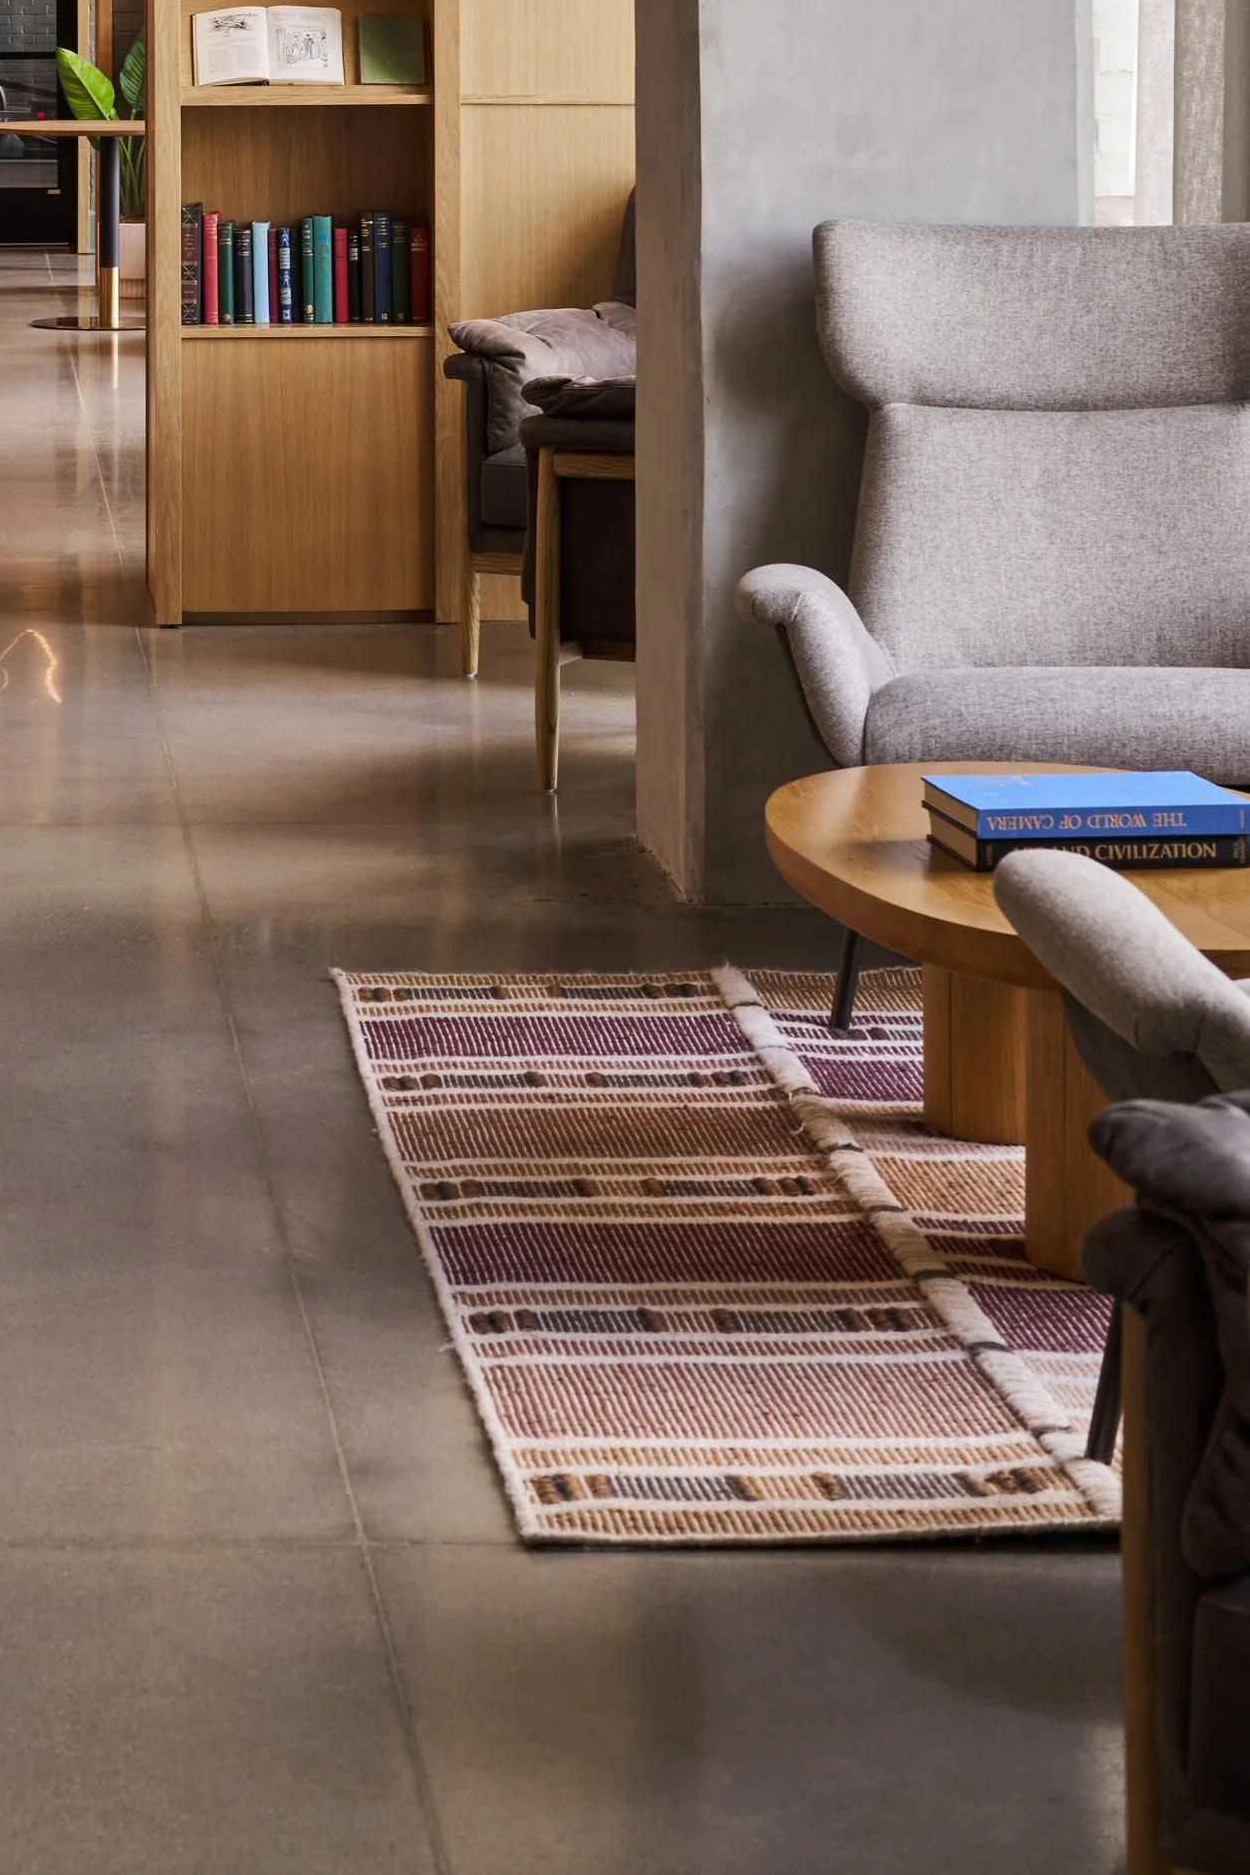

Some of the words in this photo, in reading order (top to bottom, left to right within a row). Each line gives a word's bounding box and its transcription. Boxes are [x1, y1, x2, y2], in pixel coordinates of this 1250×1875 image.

[987, 815, 1054, 830] CAMERA
[1059, 815, 1081, 829] OF
[1087, 813, 1146, 828] WORLD
[1153, 812, 1186, 827] THE
[1095, 843, 1216, 860] CIVILIZATION
